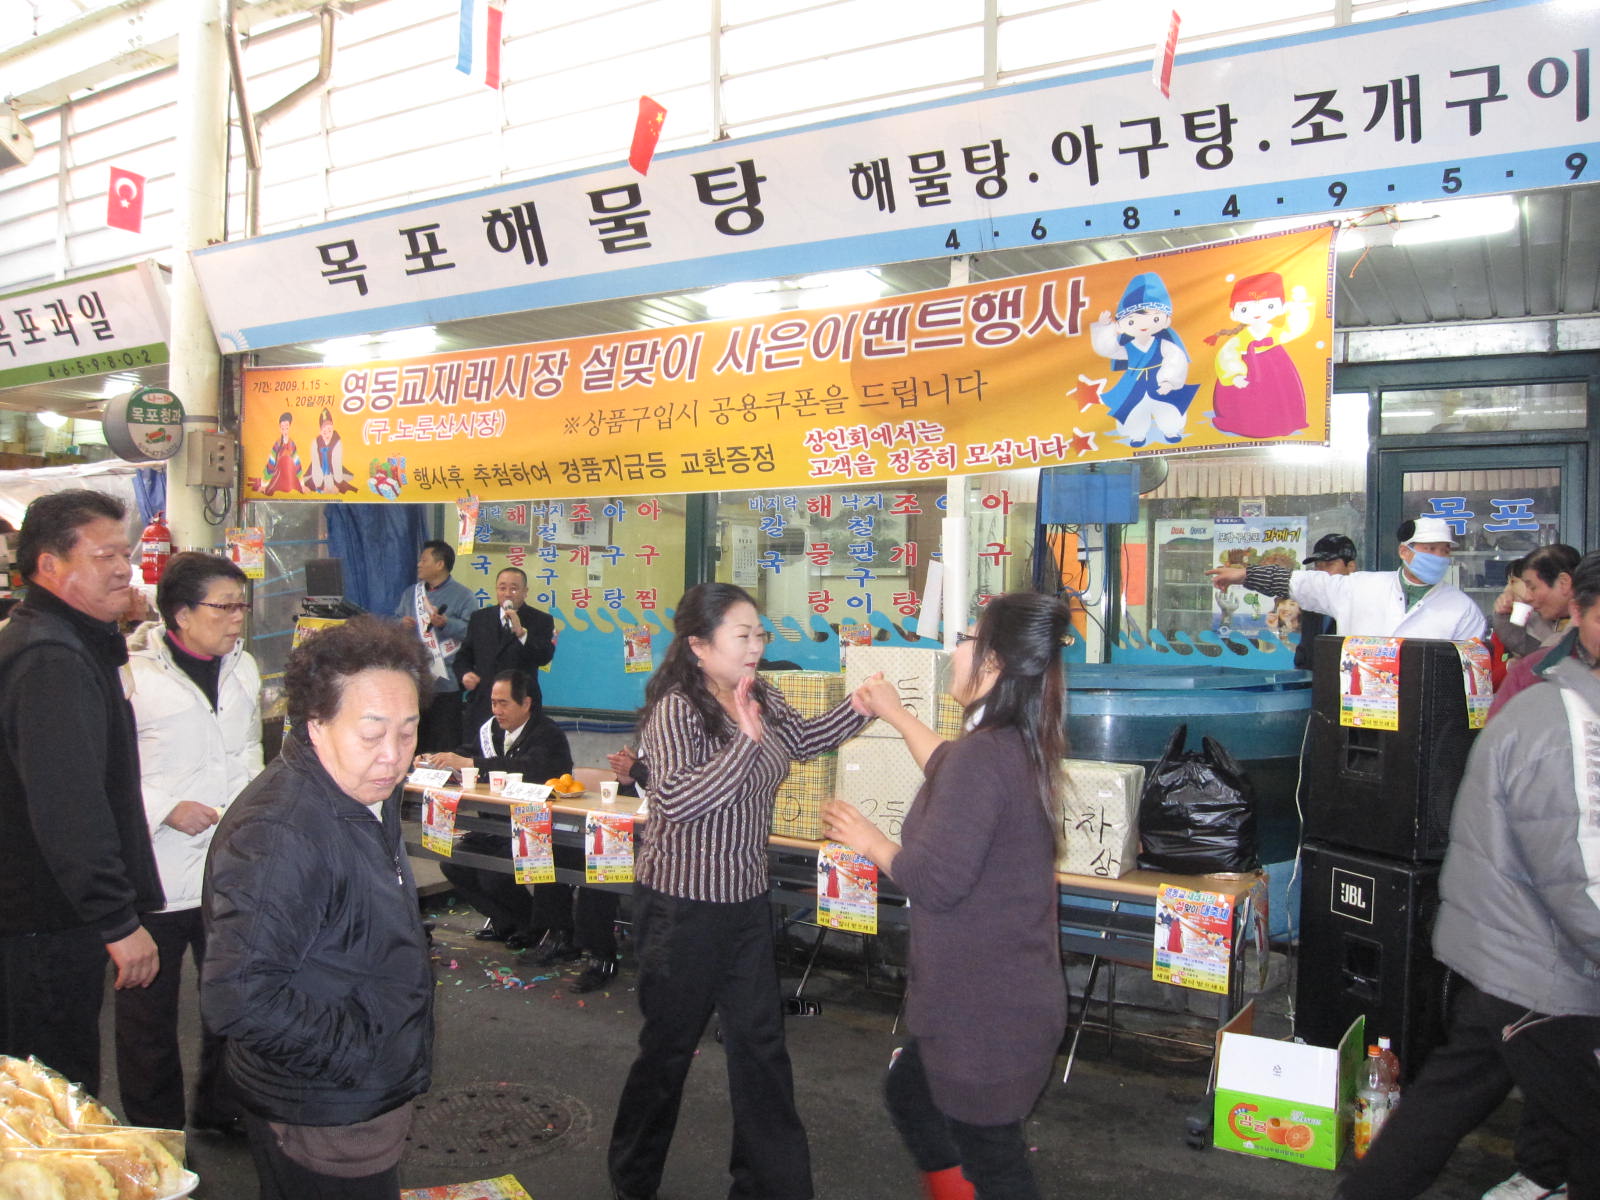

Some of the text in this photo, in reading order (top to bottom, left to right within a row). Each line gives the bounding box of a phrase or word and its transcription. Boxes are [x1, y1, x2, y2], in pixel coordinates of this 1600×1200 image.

[316, 159, 767, 296] 목포해물탕
[342, 350, 568, 413] 영동교재래시장
[582, 332, 702, 393] 설맞이
[132, 407, 181, 424] 목포청과
[708, 384, 849, 426] 공용쿠폰을
[858, 369, 989, 409] 드립니다
[363, 410, 505, 444] (구.노룬산시장)
[805, 421, 943, 449] 상인회에서는
[413, 443, 776, 490] 행사후 추첨하여 경품지급등 교환증정
[809, 436, 1069, 478] 고객을 정중히 모십니다
[1340, 882, 1366, 909] JBL
